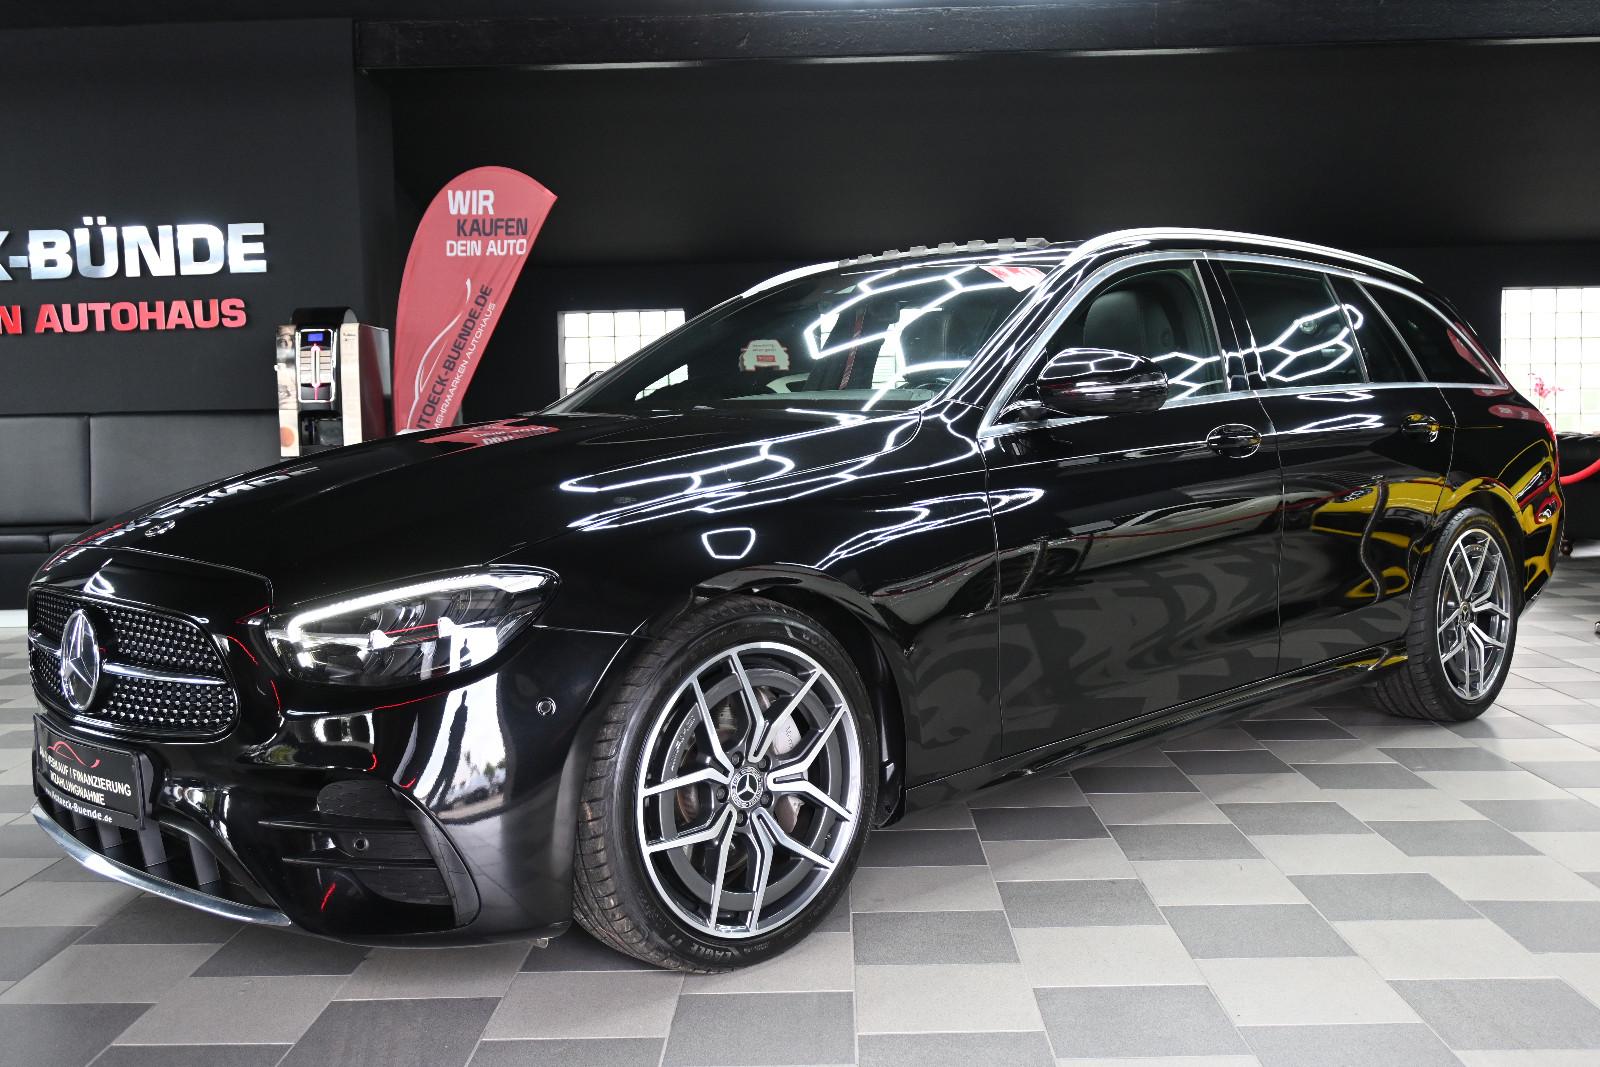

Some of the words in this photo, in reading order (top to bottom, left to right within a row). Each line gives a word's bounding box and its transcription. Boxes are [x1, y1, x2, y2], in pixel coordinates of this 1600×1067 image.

[447, 189, 495, 216] WIR
[456, 217, 528, 237] KAUFEN
[0, 215, 267, 281] -BÜNDE
[446, 239, 481, 257] DEIN
[486, 238, 527, 256] AUTO
[34, 298, 248, 334] AUTOHAUS
[465, 302, 496, 360] AUTOHAUS
[72, 768, 132, 797] FINANZIERUNG
